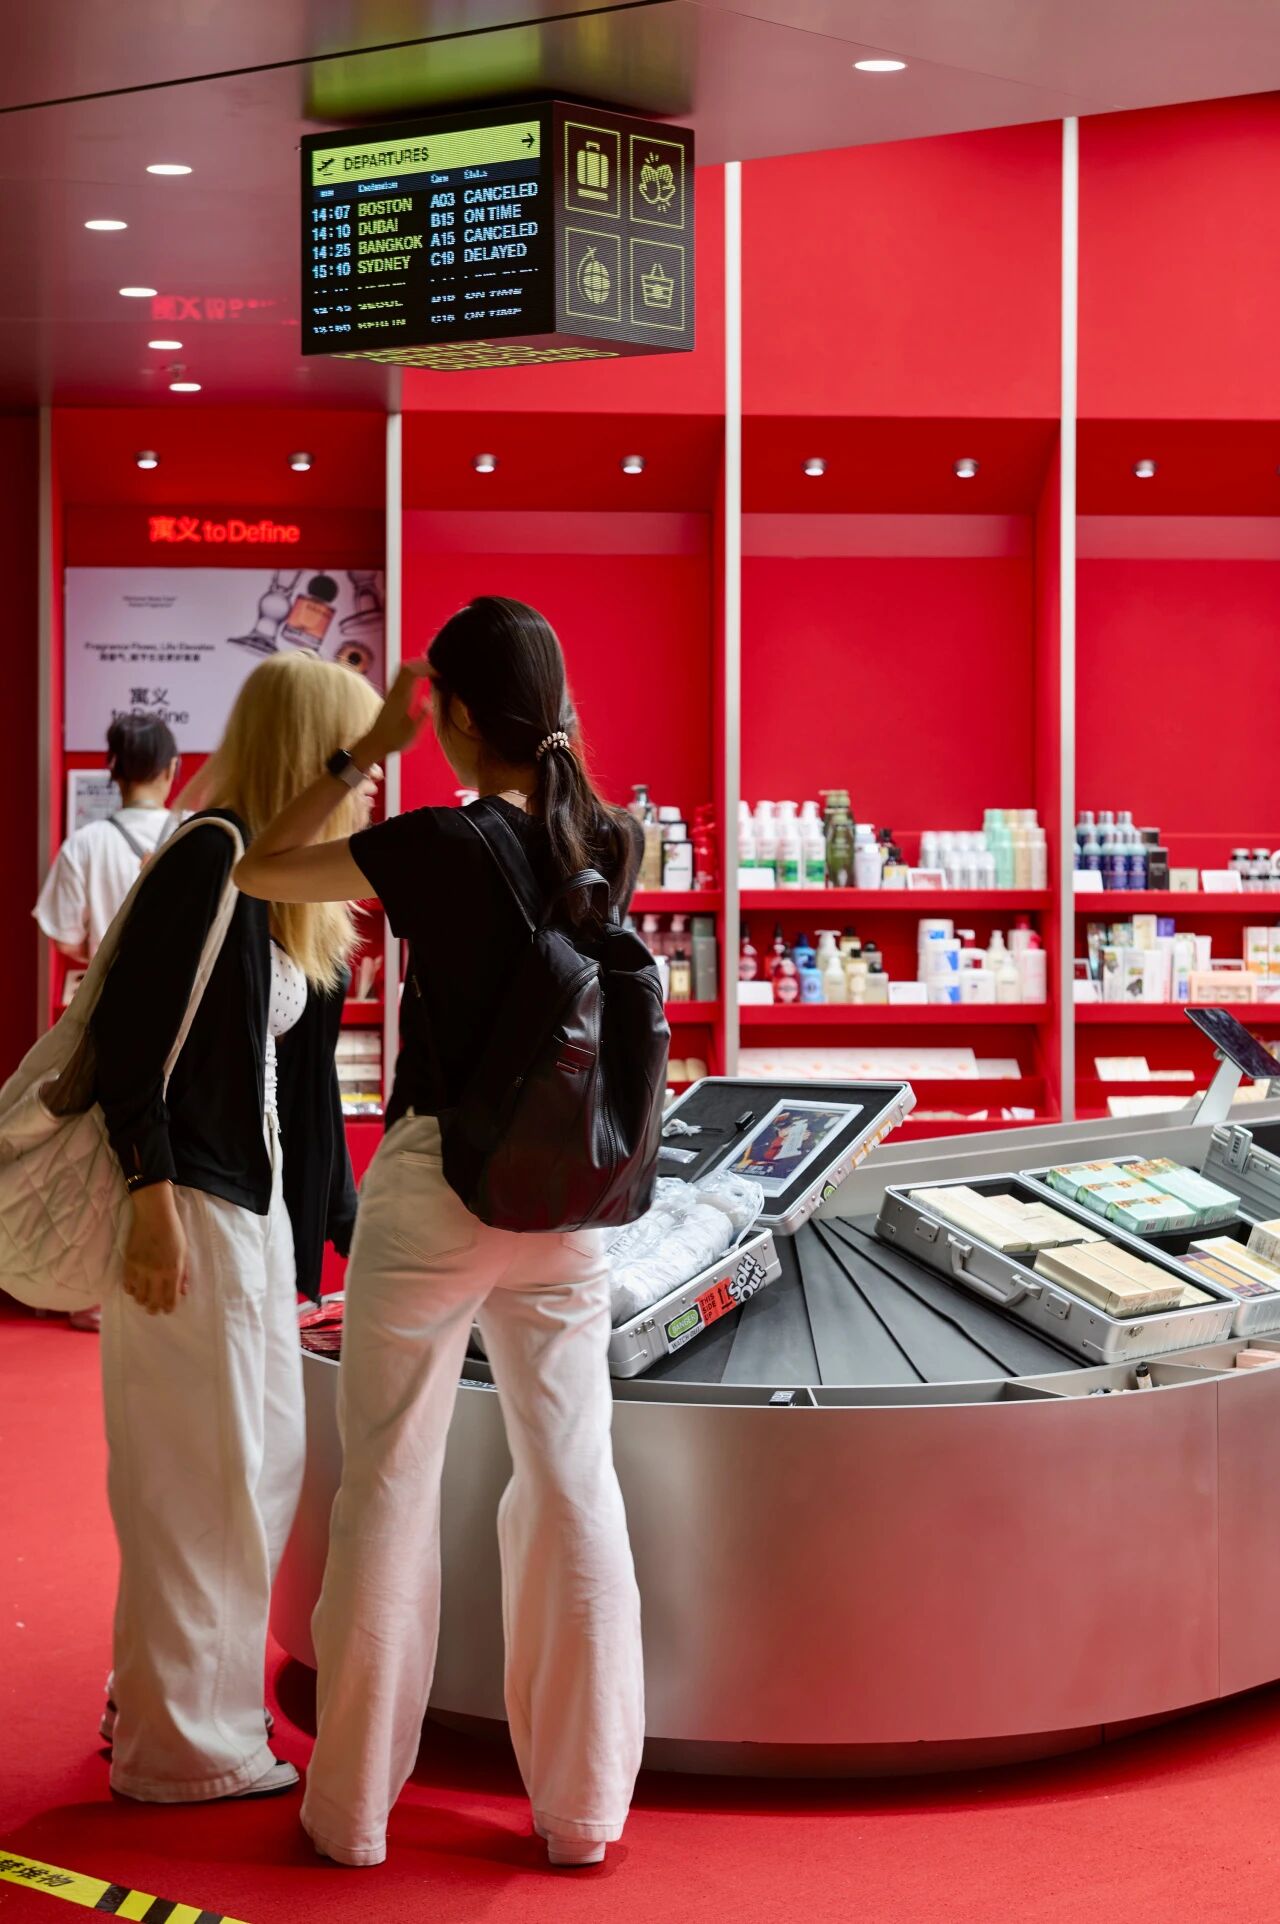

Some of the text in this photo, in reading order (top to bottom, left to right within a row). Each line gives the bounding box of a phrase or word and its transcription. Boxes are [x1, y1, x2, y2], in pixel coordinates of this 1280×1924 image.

[343, 146, 430, 171] DEPARTURES
[312, 182, 539, 222] 14:07 BOSTON A03 CANCELED
[312, 204, 522, 241] 14:10 DUBAI B15 ON TIME
[312, 221, 539, 260] 14:25 BANGKOK A15 CANCELED
[312, 262, 351, 279] 15:10
[357, 255, 411, 275] SYDNEY
[430, 250, 455, 267] C19
[463, 243, 528, 263] DELAYED
[728, 1252, 757, 1301] Sold
[741, 1264, 767, 1302] Out
[700, 1293, 715, 1307] THIS
[702, 1300, 717, 1314] SIDE
[704, 1311, 713, 1321] UP
